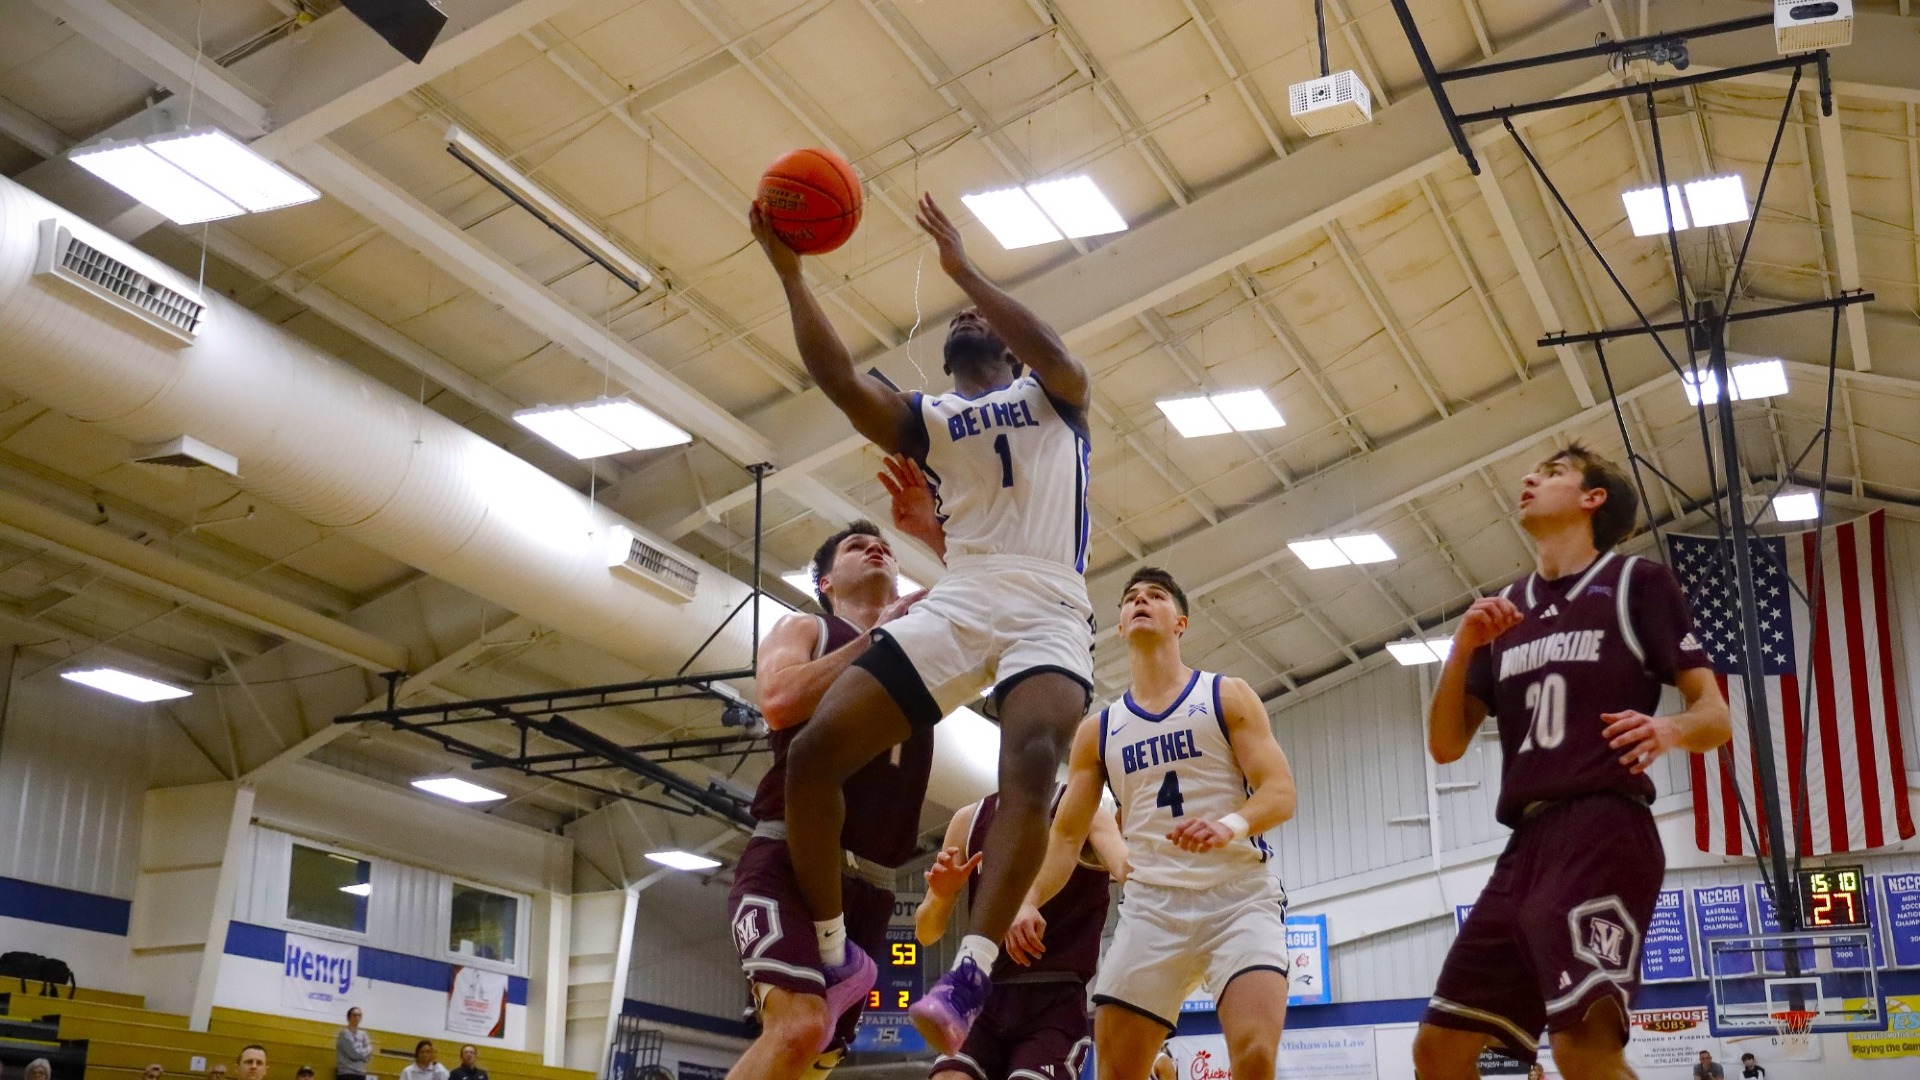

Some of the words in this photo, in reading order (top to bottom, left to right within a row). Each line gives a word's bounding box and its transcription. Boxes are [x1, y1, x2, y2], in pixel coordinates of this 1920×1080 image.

[948, 400, 1040, 442] BETHEL
[994, 434, 1014, 489] 1
[1499, 629, 1606, 682] MORNINGSIDE
[1517, 672, 1568, 754] 20
[1122, 729, 1203, 775] BETHEL
[1156, 770, 1185, 818] 4
[1656, 893, 1680, 907] CAA
[1699, 888, 1741, 905] NCCAA
[1901, 895, 1920, 903] MEN'
[1705, 907, 1737, 916] BASEBALL
[1811, 892, 1855, 925] 27
[1901, 903, 1920, 911] SOCC
[1651, 911, 1677, 919] OMEN'S
[1704, 914, 1739, 923] NATIONAL
[1650, 919, 1681, 928] LLEYBALL
[1703, 922, 1743, 931] CHAMPIONS
[1646, 927, 1680, 936] NATIONAL
[1286, 932, 1316, 947] AGUE
[1644, 935, 1683, 944] CHAMPIONS
[891, 943, 917, 965] 53
[285, 943, 352, 994] Henry
[898, 990, 909, 1008] 2
[1629, 1010, 1709, 1027] FIREHOUSE
[1654, 1020, 1686, 1031] SUBS
[1281, 1039, 1341, 1051] Mishawaka
[1343, 1038, 1365, 1048] Law
[1852, 1043, 1885, 1055] Playing
[1885, 1041, 1901, 1052] the
[1902, 1040, 1920, 1051] Gam
